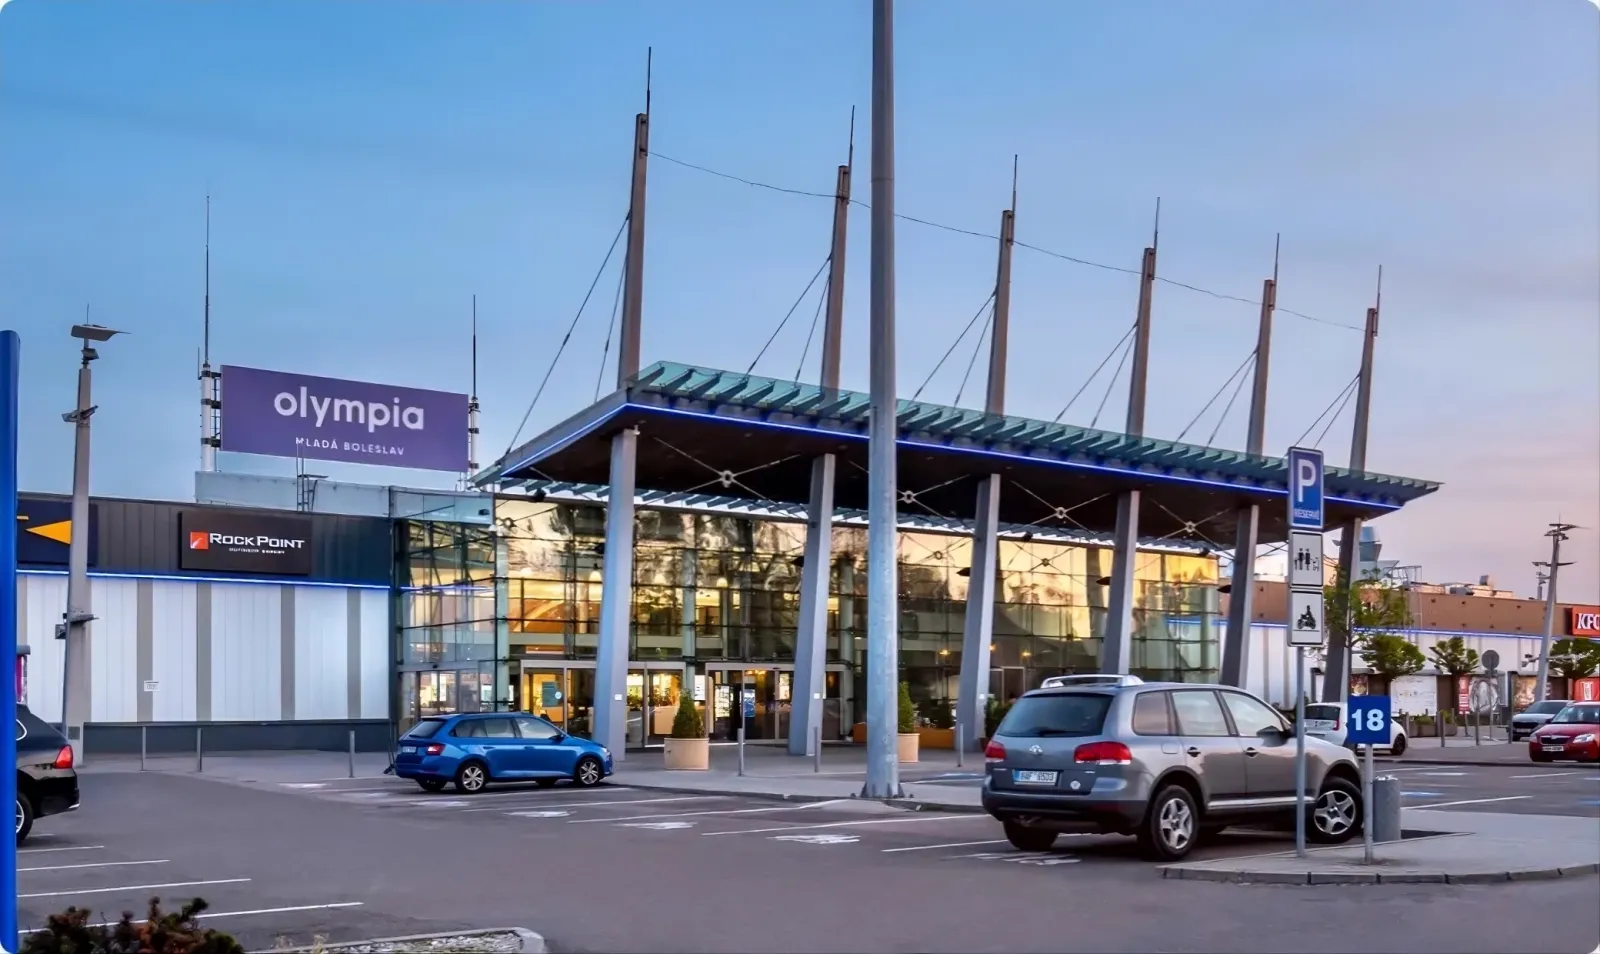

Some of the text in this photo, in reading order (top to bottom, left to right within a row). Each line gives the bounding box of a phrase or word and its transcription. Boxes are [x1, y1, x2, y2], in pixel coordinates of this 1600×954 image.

[274, 386, 425, 433] olympia
[295, 437, 404, 456] MLADÁ BOLESLAV
[1298, 459, 1316, 502] P
[209, 532, 305, 549] ROCK POINT
[1352, 708, 1385, 731] 18
